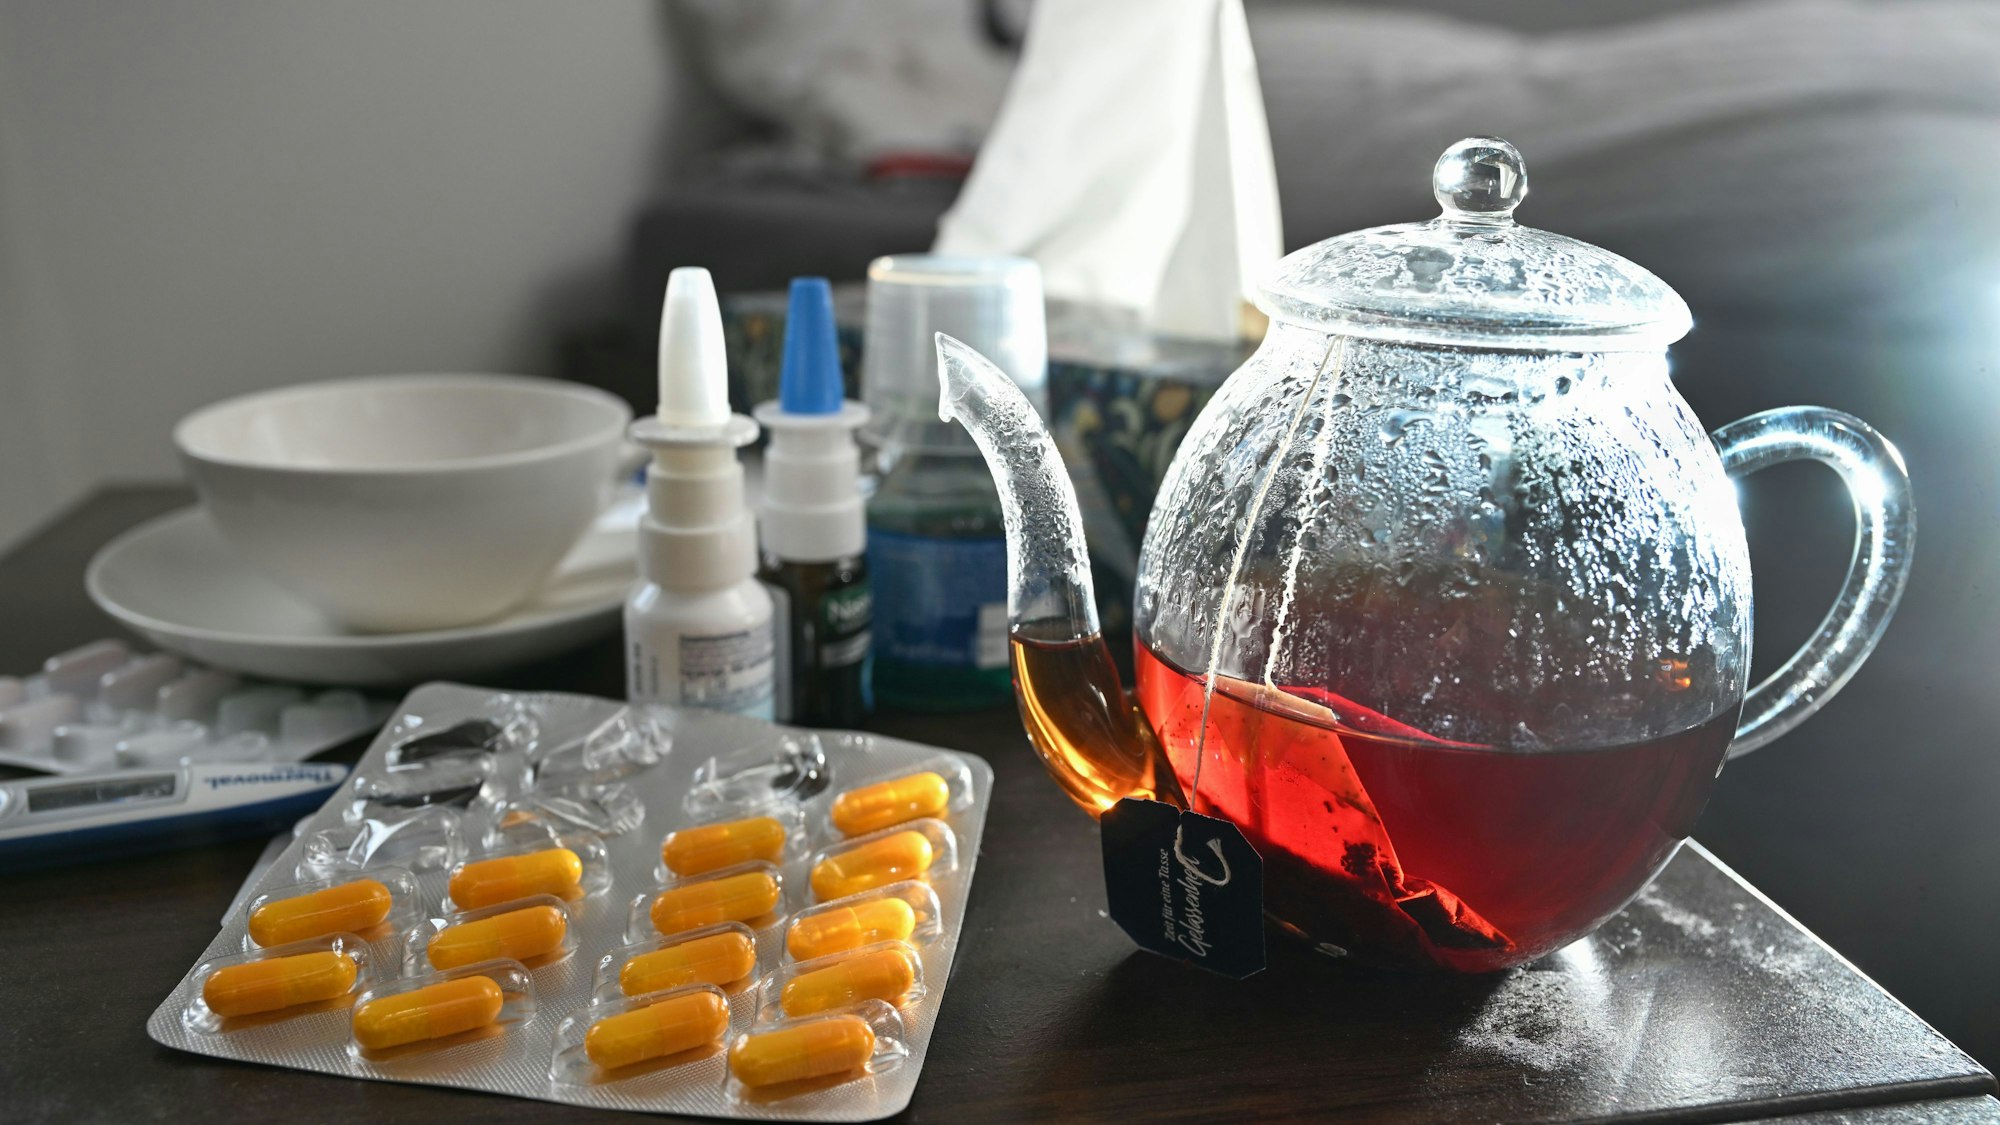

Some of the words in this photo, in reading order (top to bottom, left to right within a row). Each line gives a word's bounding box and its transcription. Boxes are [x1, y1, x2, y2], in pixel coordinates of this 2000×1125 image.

[1159, 848, 1170, 878] Tasse
[1161, 880, 1172, 903] eine
[1163, 903, 1176, 920] für
[1178, 856, 1212, 957] Gelassenhet
[1164, 920, 1176, 941] Zeit
